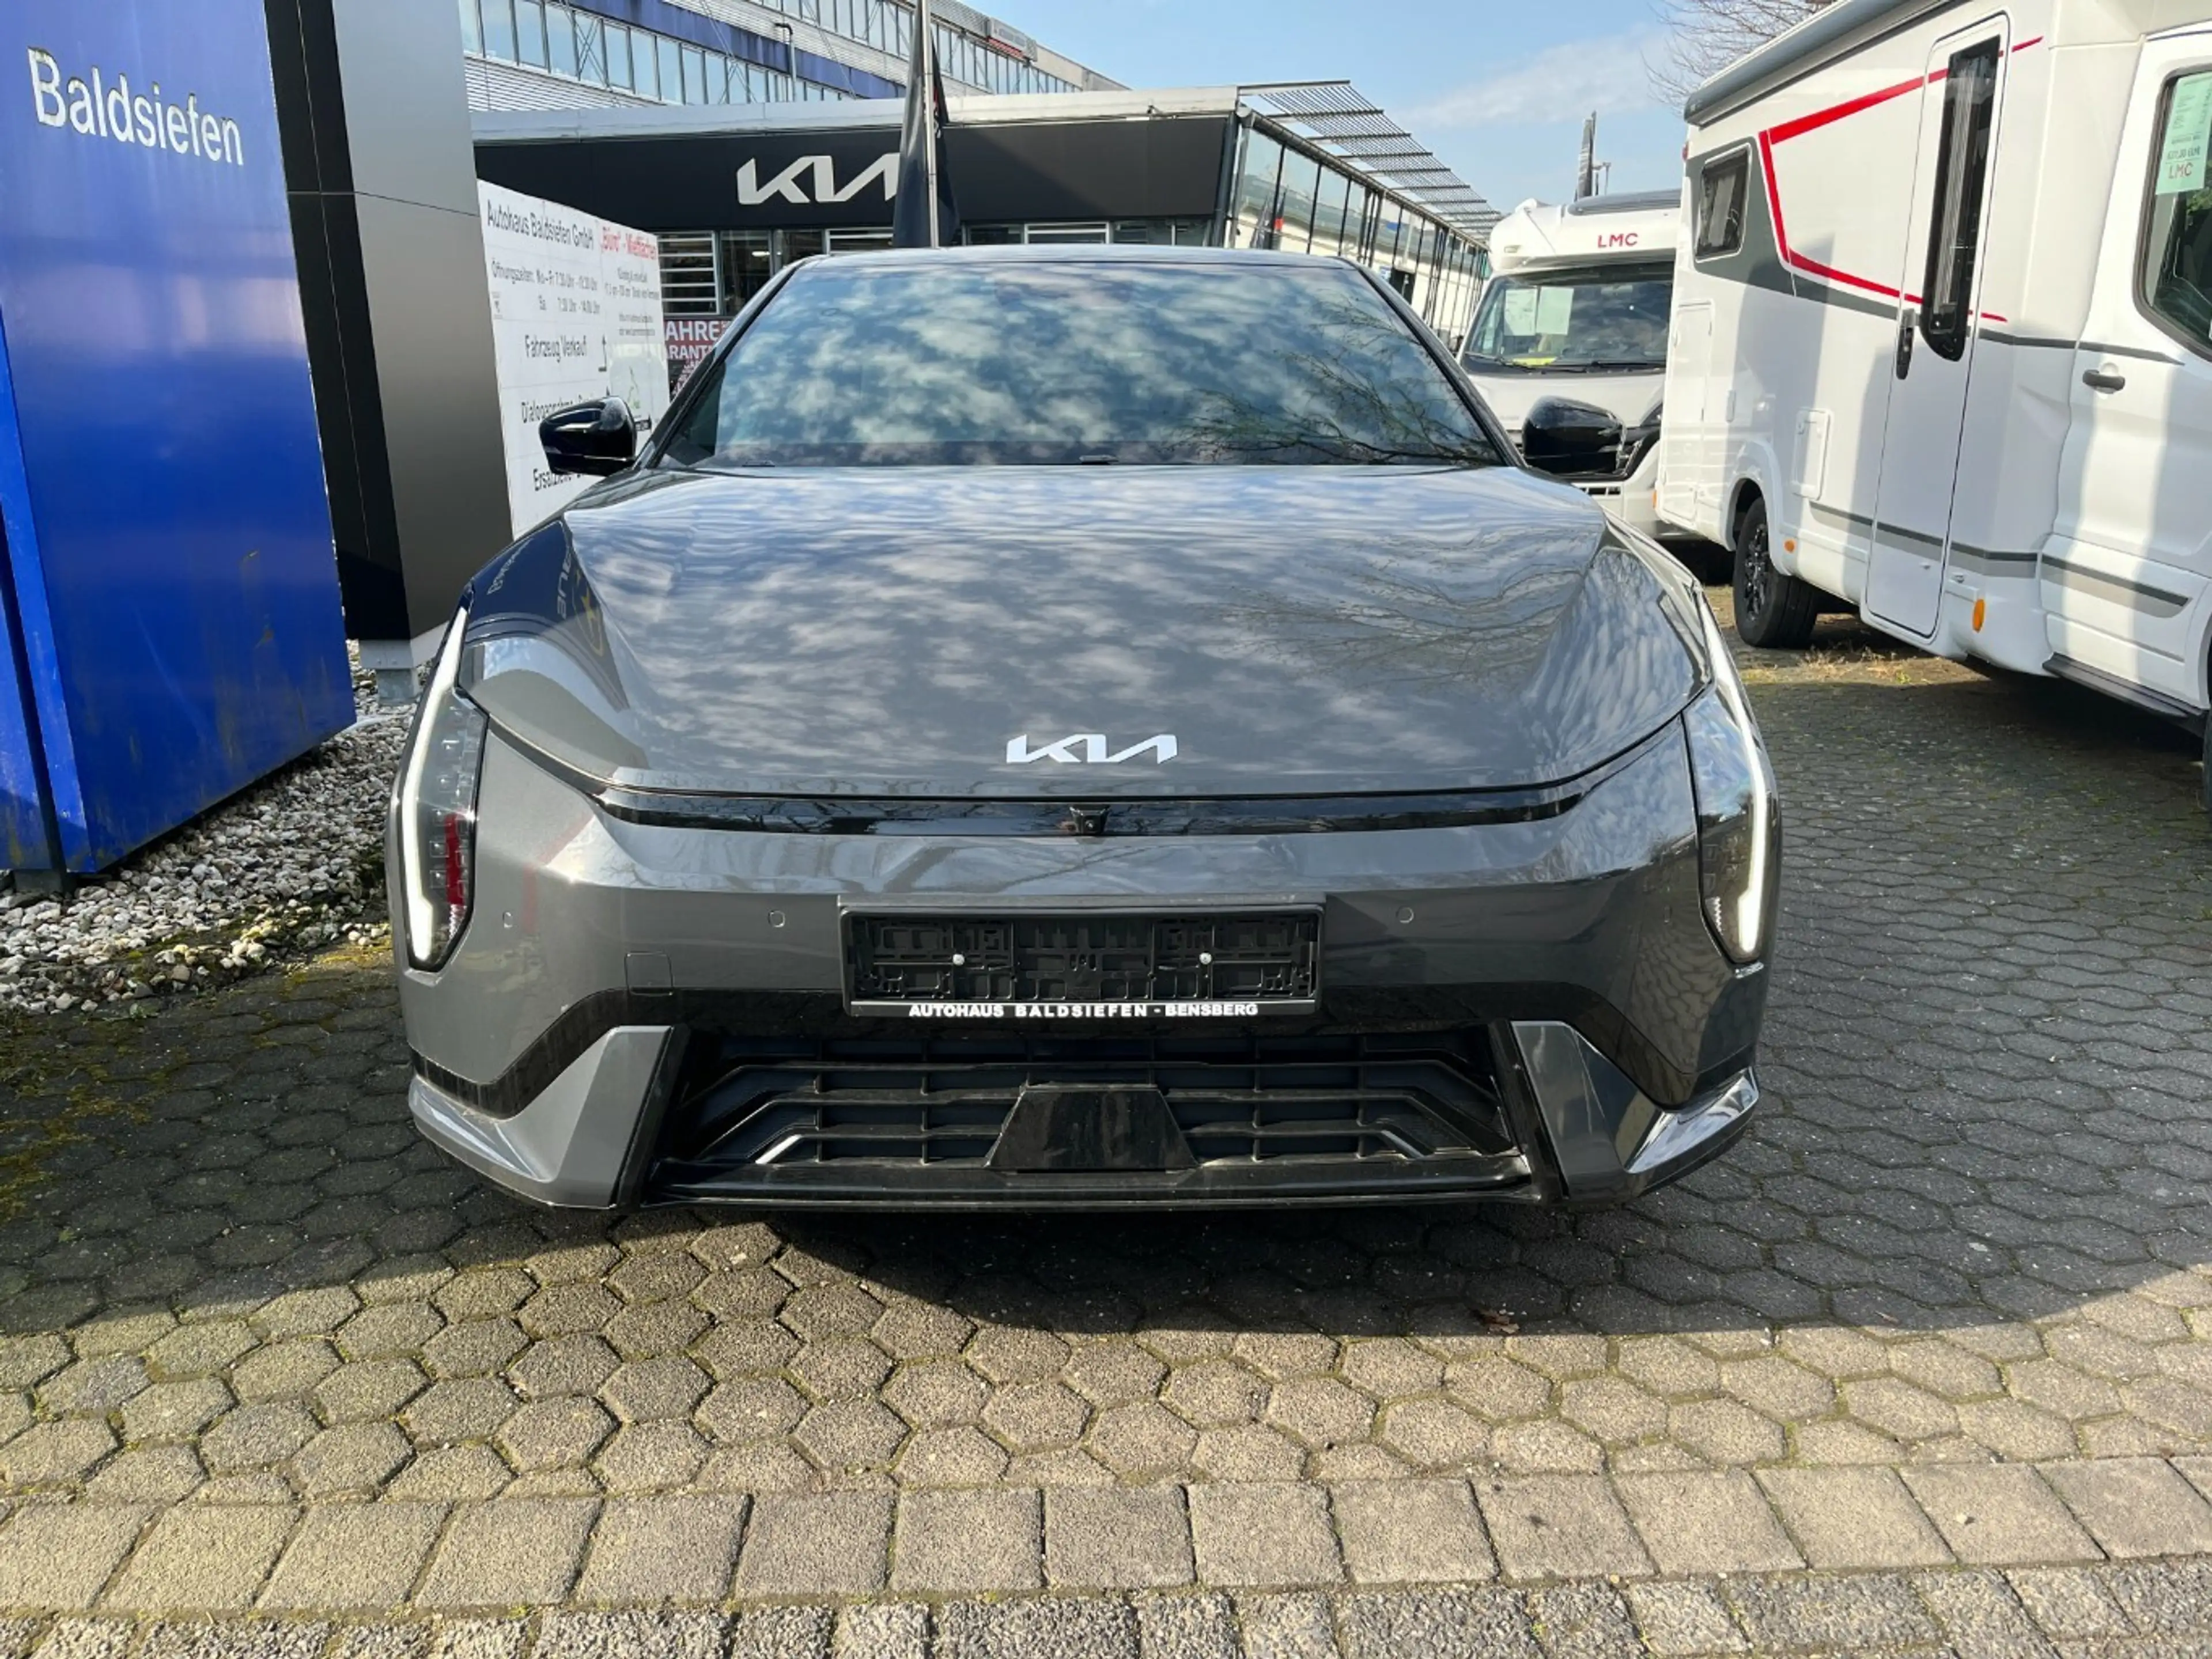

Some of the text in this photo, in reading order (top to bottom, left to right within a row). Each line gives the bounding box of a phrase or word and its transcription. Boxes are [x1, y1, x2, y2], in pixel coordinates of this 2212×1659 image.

[28, 46, 244, 166] Baldsiefen
[737, 152, 901, 204] KIA
[2168, 162, 2194, 179] LMC
[487, 199, 595, 251] Autohaus Baldsiefen GmbH
[1598, 232, 1639, 248] LMC
[664, 320, 719, 342] AHRE
[524, 334, 587, 363] Fahrzeug Verkauf
[1007, 733, 1178, 764] KIA
[909, 1003, 1004, 1018] AUTOHAUS
[1015, 1003, 1148, 1018] BALDSIEFEN
[1164, 1002, 1258, 1017] BENSBERG
